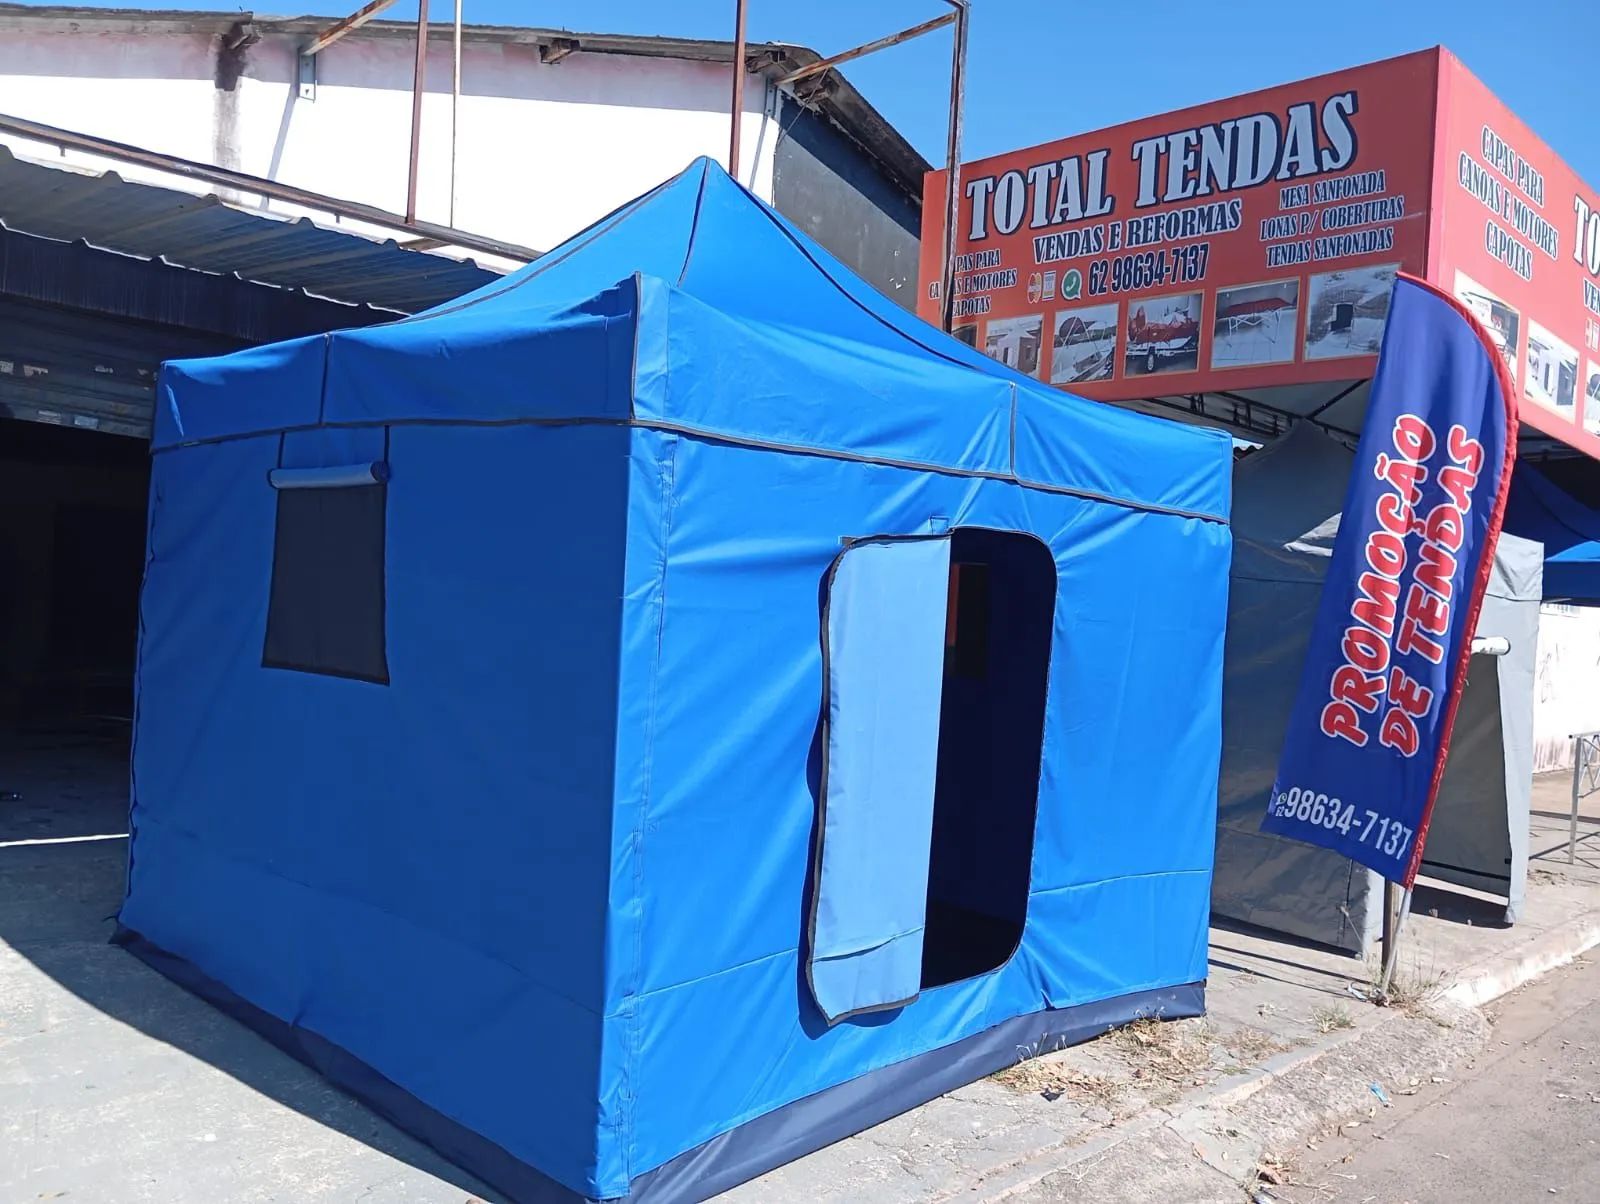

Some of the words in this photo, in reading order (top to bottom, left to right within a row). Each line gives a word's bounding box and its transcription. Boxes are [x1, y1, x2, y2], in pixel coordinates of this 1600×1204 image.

[966, 150, 1114, 239] TOTAL
[1132, 92, 1358, 206] TENDAS
[1279, 184, 1310, 210] MESA
[1313, 169, 1385, 204] SANFONADA
[1482, 125, 1515, 181] CAPAS
[1517, 157, 1544, 206] PARA
[1033, 224, 1103, 264] VENDAS
[1107, 222, 1121, 250] E
[1125, 198, 1243, 248] REFORMAS
[1260, 213, 1298, 241] LONAS
[1300, 210, 1319, 234] P/
[1321, 195, 1404, 230] COBERTURAS
[1459, 151, 1501, 214] CANOAS
[1503, 187, 1511, 222] E
[1512, 196, 1558, 260] MOTORES
[954, 253, 974, 274] PAS
[974, 248, 1001, 271] PARA
[1088, 259, 1109, 296] 62
[1111, 243, 1209, 293] 98634-7137
[1266, 241, 1311, 268] TENDAS
[1313, 226, 1394, 260] SANFONADAS
[1486, 220, 1532, 281] CAPOTAS
[963, 275, 973, 294] E
[972, 268, 1017, 291] MOTORES
[1397, 423, 1485, 664] TENDAS
[1320, 413, 1436, 748] PROMOÇÃO
[1379, 667, 1433, 758] DE
[1284, 786, 1413, 860] 98634-7137
